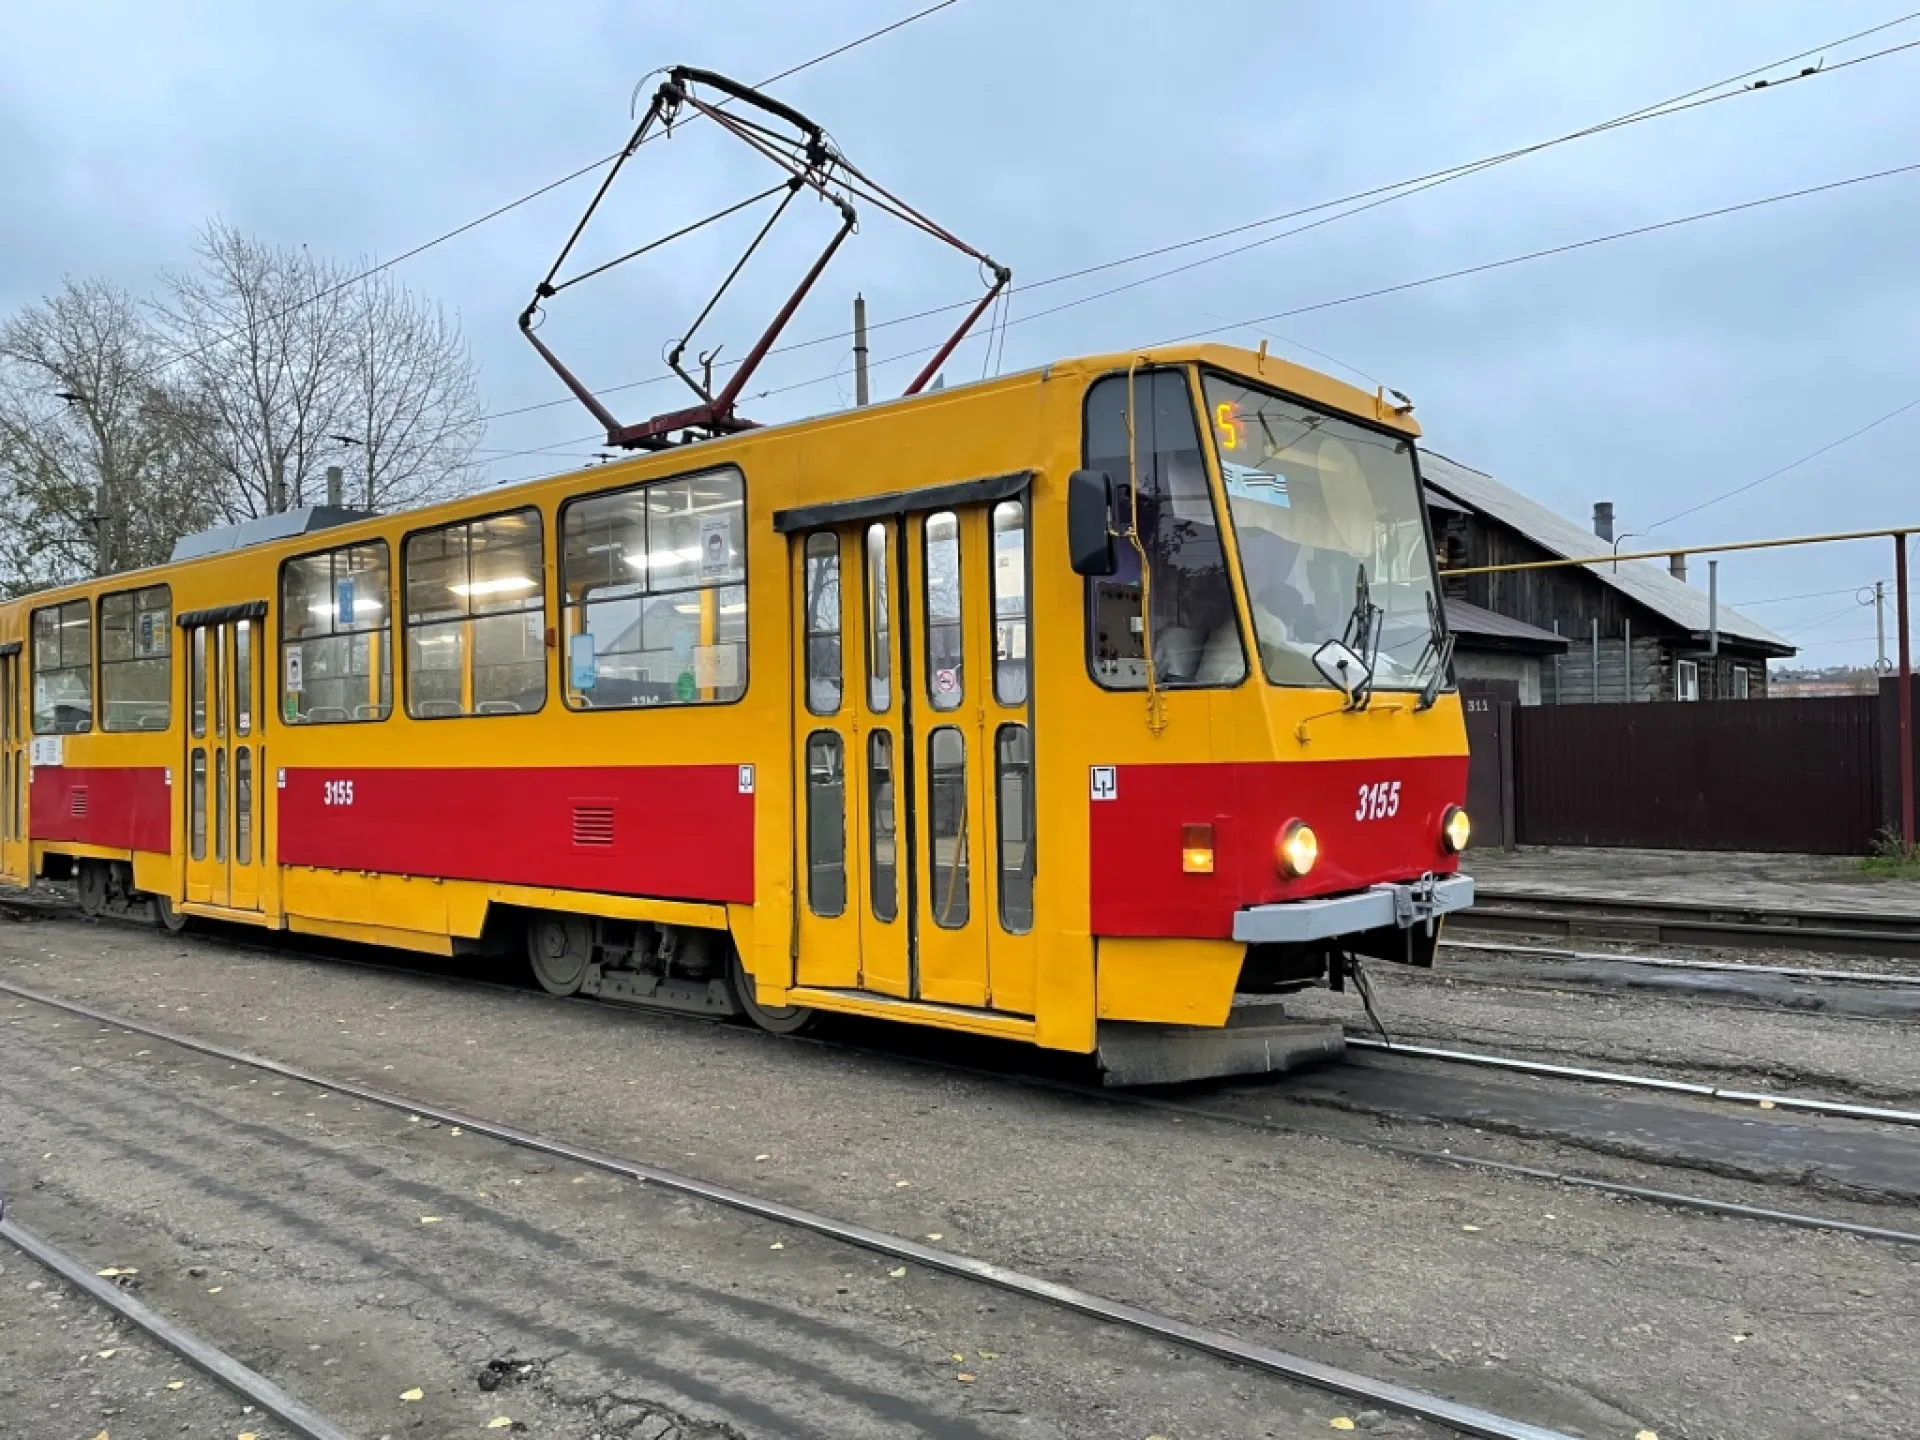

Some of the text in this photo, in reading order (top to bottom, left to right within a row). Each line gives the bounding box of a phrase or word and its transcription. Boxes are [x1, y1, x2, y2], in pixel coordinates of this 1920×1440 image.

[1216, 403, 1236, 449] 5
[1467, 699, 1490, 712] 311
[323, 780, 354, 806] 3155
[1355, 780, 1402, 822] 3155
